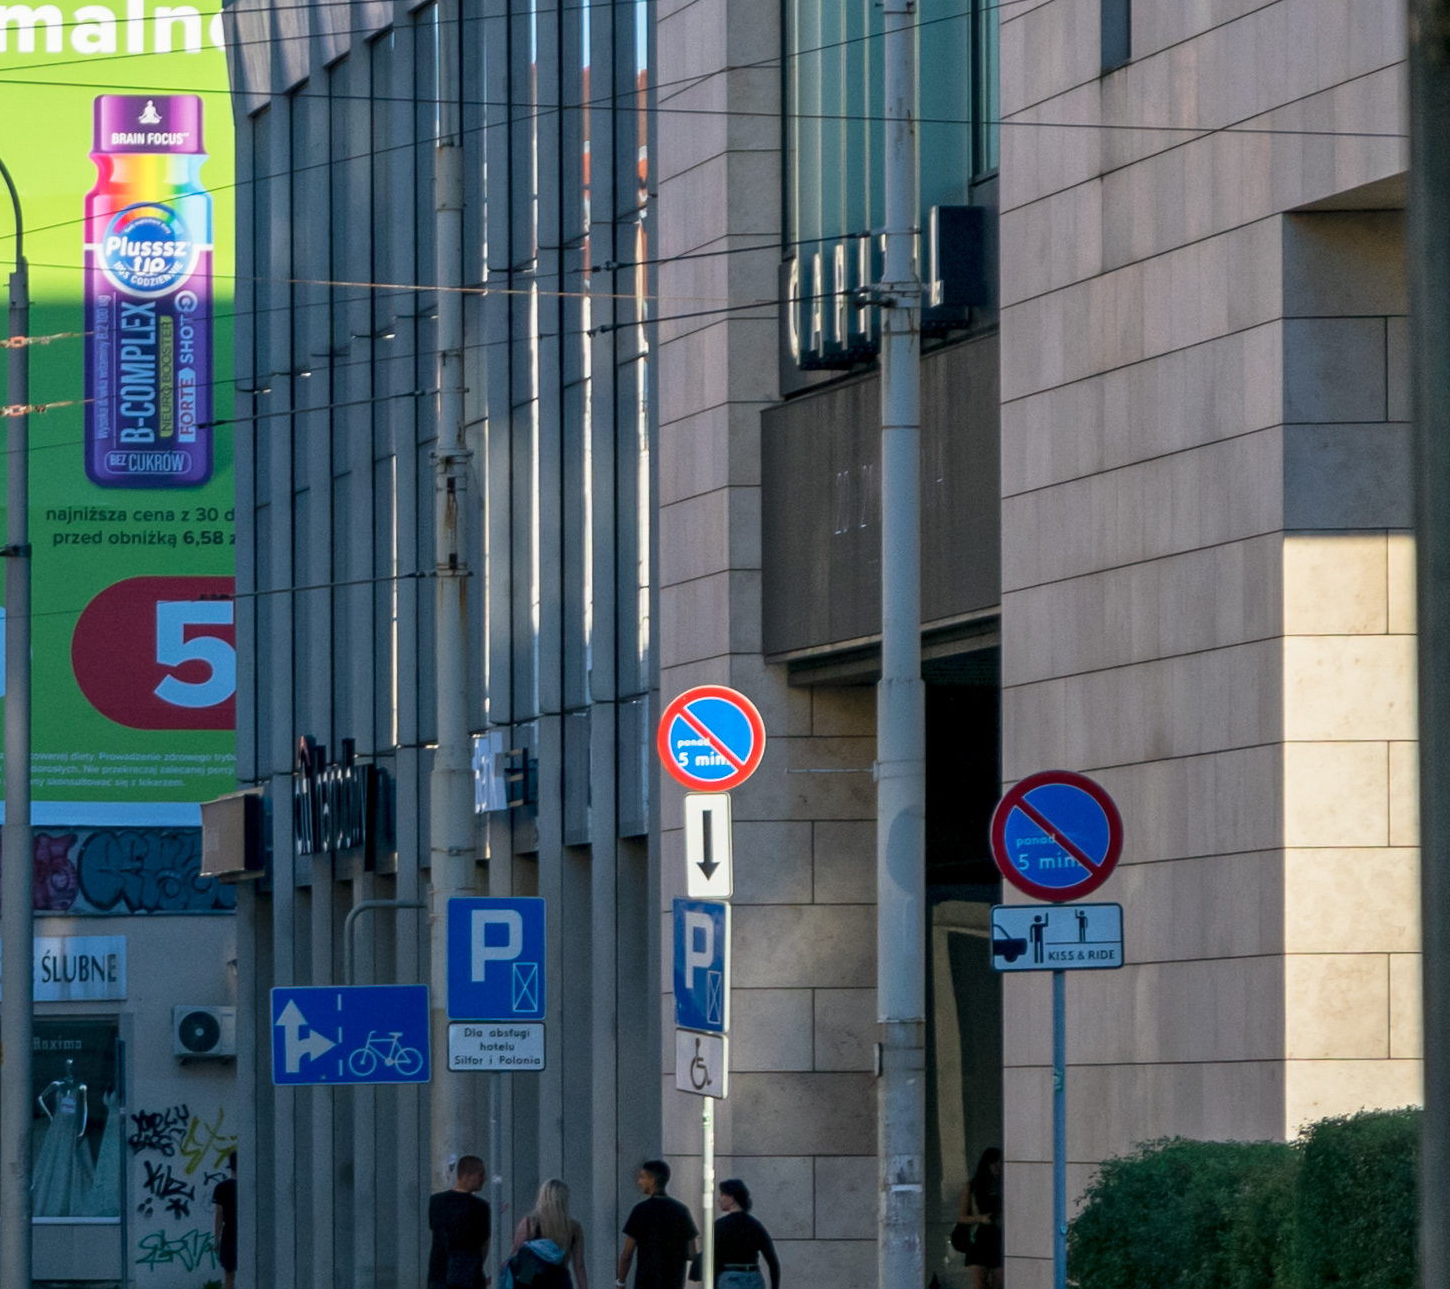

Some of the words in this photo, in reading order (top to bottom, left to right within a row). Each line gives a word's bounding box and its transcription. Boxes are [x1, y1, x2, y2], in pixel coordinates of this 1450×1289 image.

[111, 133, 145, 145] BRAIN
[180, 314, 194, 364] SHOT
[161, 321, 172, 384] BOOSTER
[120, 301, 156, 442] B-COMPLEX
[161, 387, 172, 432] NEURO
[180, 378, 194, 435] FORTE
[110, 454, 127, 466] BEZ
[129, 450, 185, 471] CUKRÓW
[46, 506, 127, 524] najniższa
[133, 510, 175, 522] cena
[181, 511, 190, 521] z
[195, 507, 219, 522] 30
[53, 531, 102, 547] przed
[108, 530, 177, 548] obniżką
[183, 531, 224, 547] 6,58
[153, 600, 236, 709] 5
[677, 737, 711, 749] ponad
[678, 752, 689, 767] 5
[1016, 833, 1056, 848] ponad
[1018, 853, 1030, 870] 5
[471, 909, 523, 982] P
[684, 911, 715, 989] P
[1048, 950, 1075, 961] KISS
[1077, 950, 1085, 960] &
[1088, 949, 1115, 960] RIDE
[41, 949, 117, 983] ŚLUBNE
[464, 1027, 483, 1038] Dla
[489, 1027, 531, 1040] obsługi
[480, 1041, 515, 1052] hotelu
[454, 1054, 484, 1065] Silfor
[489, 1055, 493, 1065] i
[499, 1055, 541, 1065] Polonia
